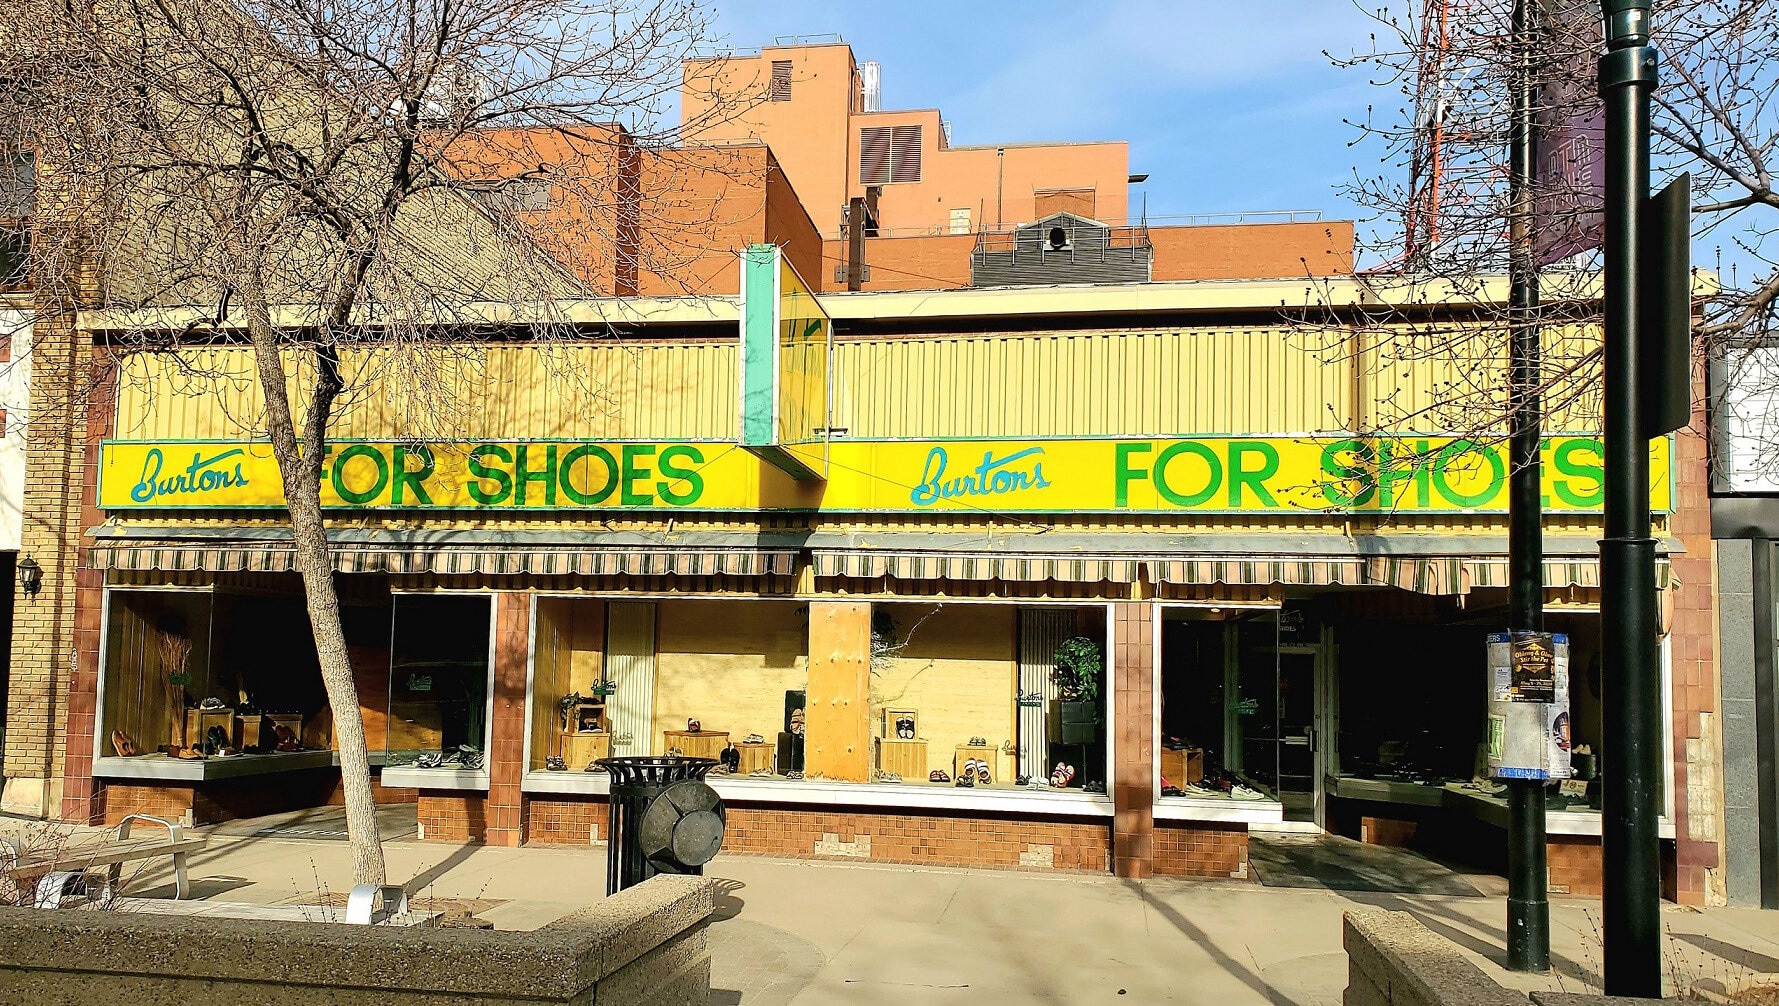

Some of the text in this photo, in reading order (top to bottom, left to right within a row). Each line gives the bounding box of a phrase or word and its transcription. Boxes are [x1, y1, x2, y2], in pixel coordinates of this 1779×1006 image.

[131, 448, 249, 503] Burtons
[466, 444, 705, 506] SHOES
[910, 439, 1604, 508] Burtons FOR SHOS
